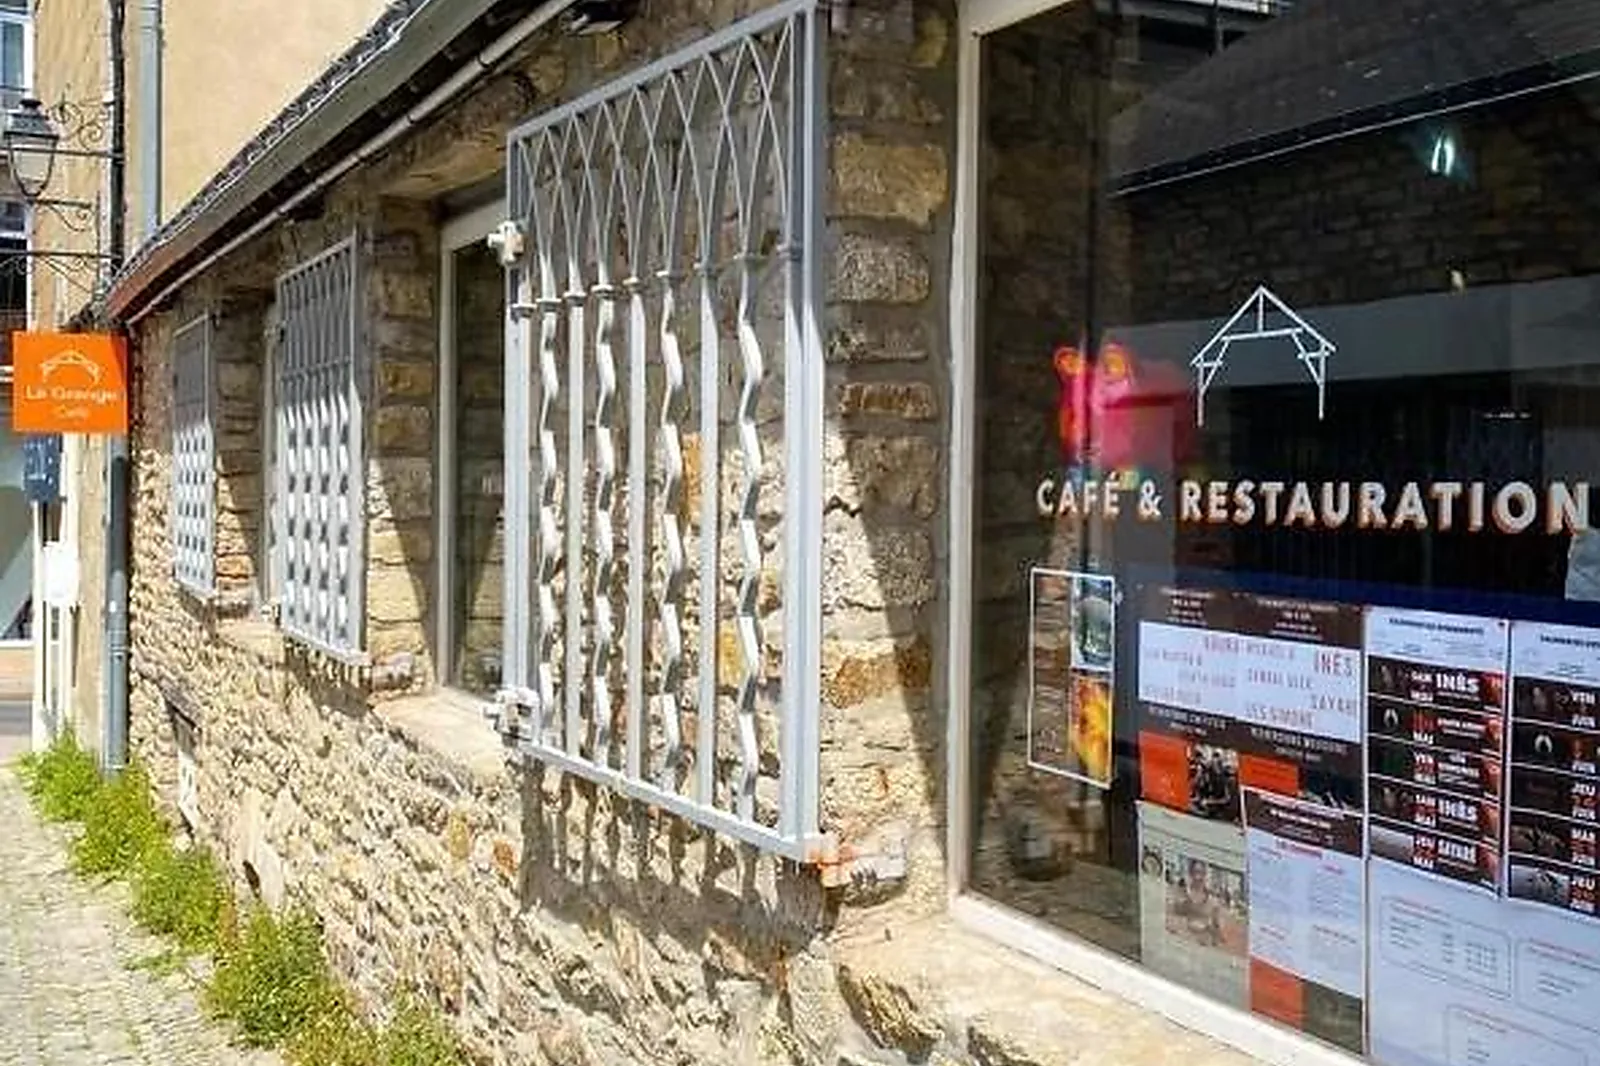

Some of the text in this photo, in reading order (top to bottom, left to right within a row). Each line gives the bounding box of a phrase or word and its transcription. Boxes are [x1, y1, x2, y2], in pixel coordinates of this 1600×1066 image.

[26, 384, 118, 405] La Grange
[1036, 471, 1590, 535] CAFÉ & RESTAURATION
